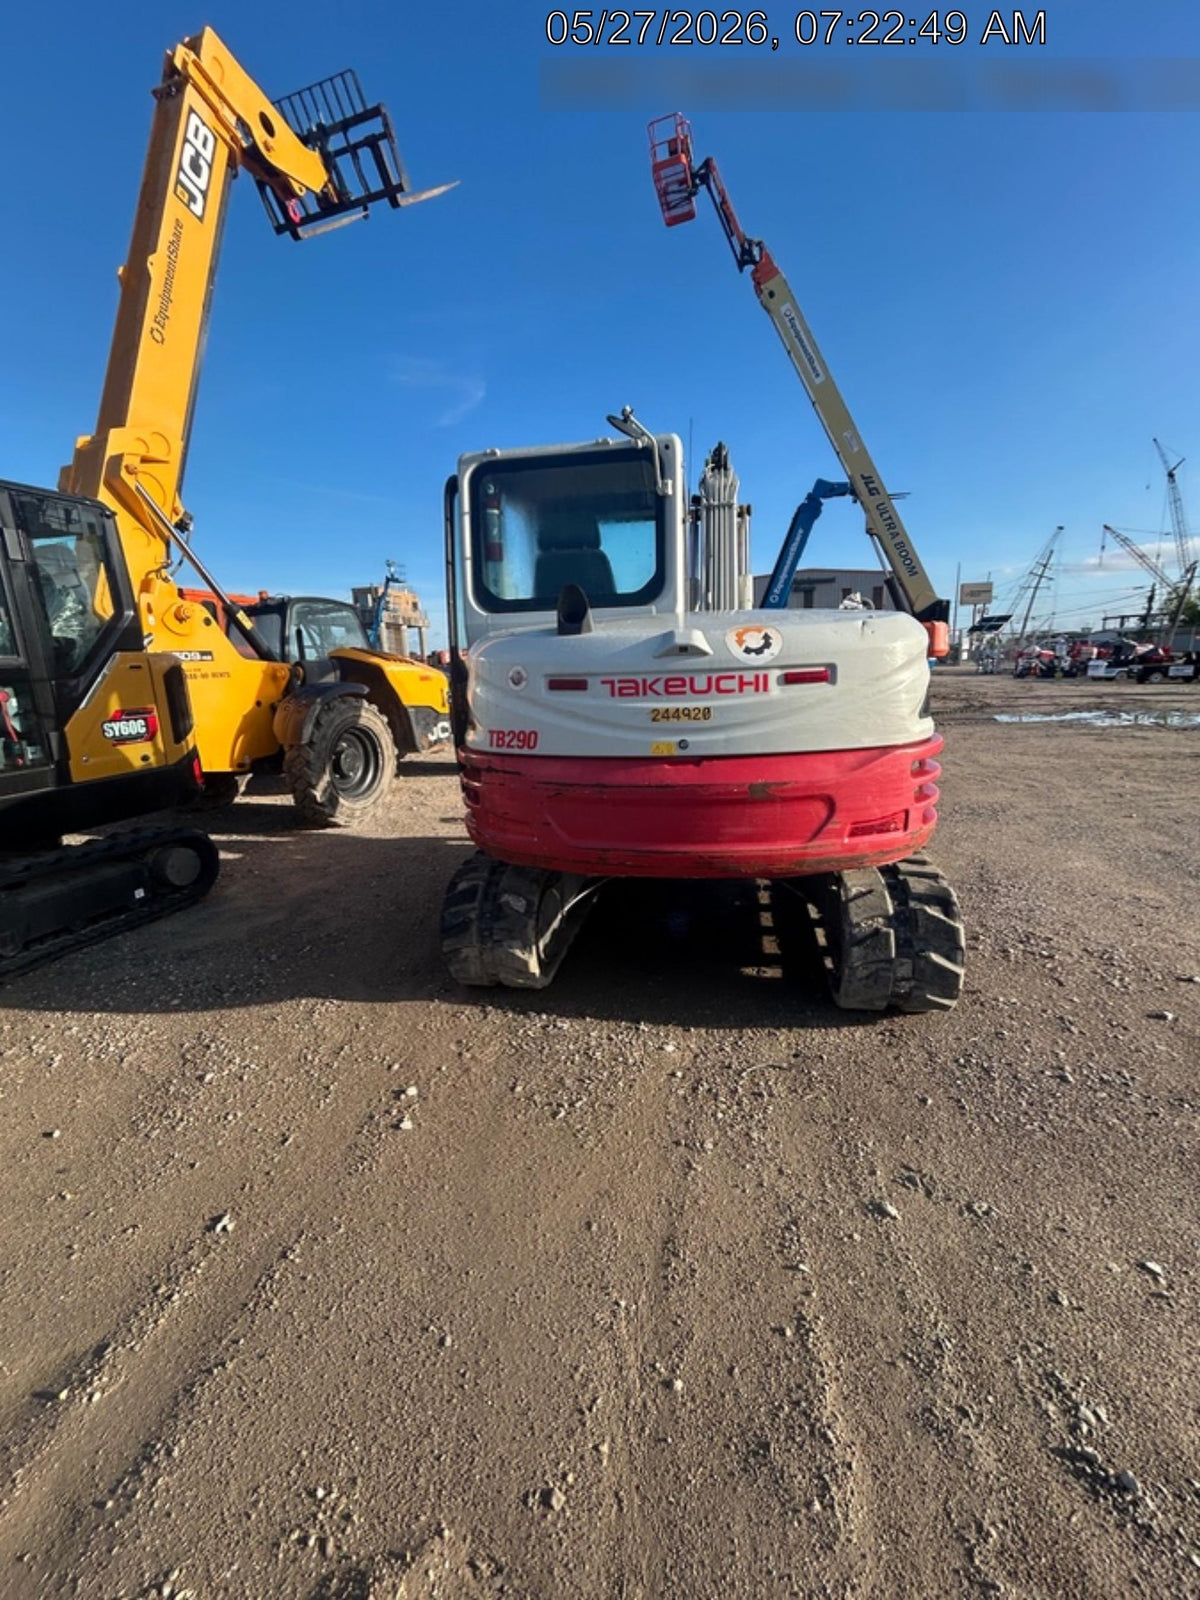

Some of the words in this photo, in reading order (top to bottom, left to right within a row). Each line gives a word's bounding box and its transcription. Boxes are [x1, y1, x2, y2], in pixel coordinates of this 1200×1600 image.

[179, 111, 216, 218] JCB
[153, 218, 184, 328] EquipmentShare
[860, 473, 881, 497] JLG
[876, 502, 900, 540] ULTRA
[893, 541, 919, 578] BOOM
[601, 673, 769, 698] TAKEUCHI
[651, 706, 712, 722] 244920
[102, 719, 147, 738] SY60C
[488, 729, 538, 750] TB290
